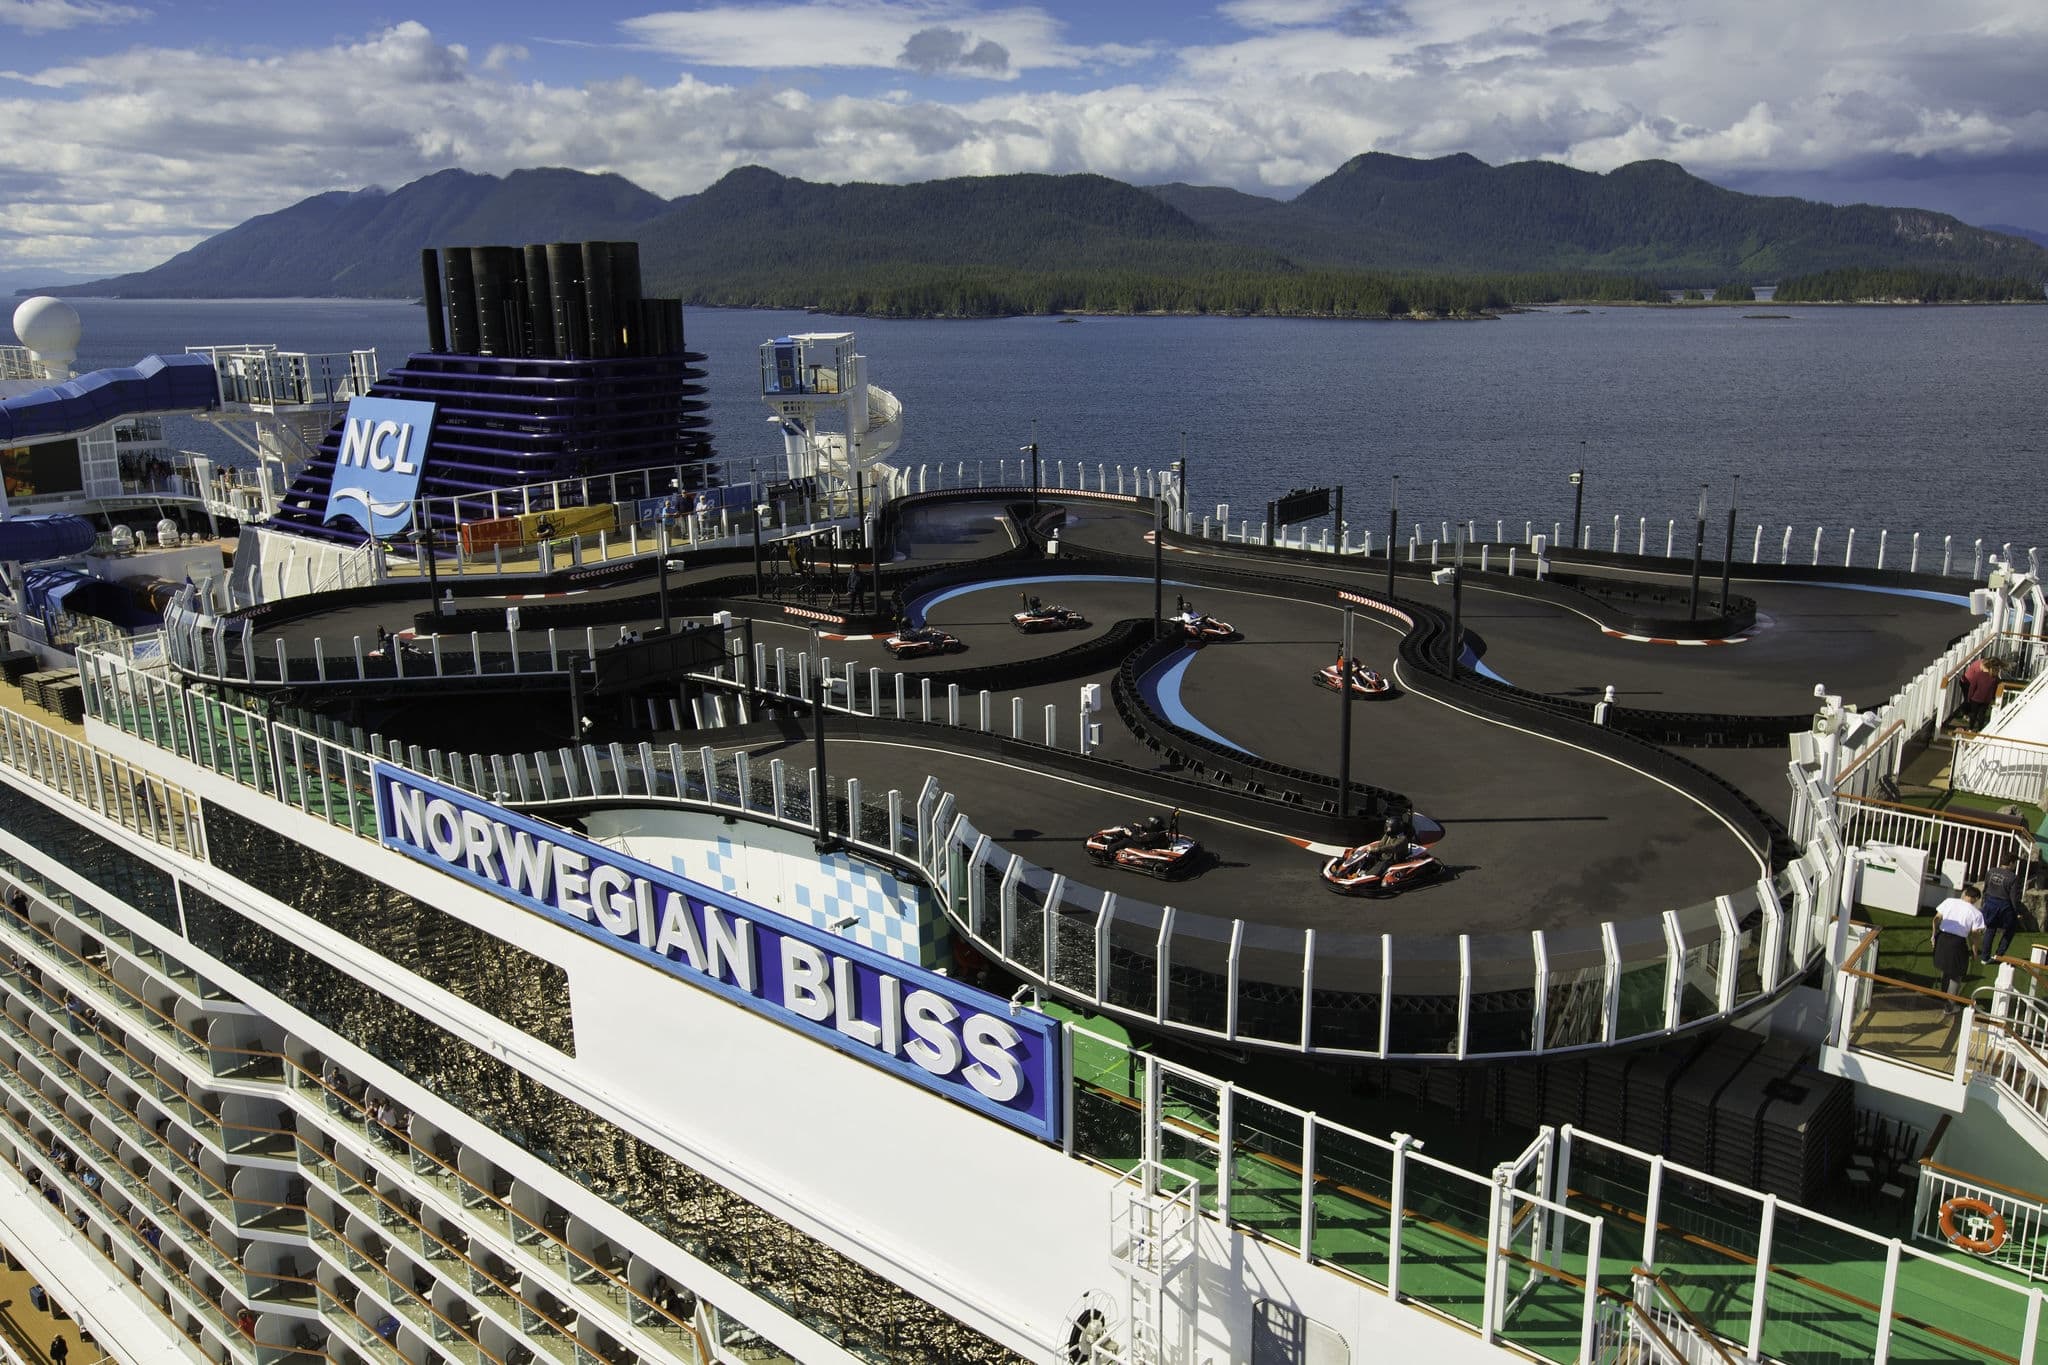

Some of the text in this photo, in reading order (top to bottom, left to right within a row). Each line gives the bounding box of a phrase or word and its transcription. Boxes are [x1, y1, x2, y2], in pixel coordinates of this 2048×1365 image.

[340, 418, 416, 474] NCL
[390, 781, 1025, 1102] NORWEGIAN BLISS
